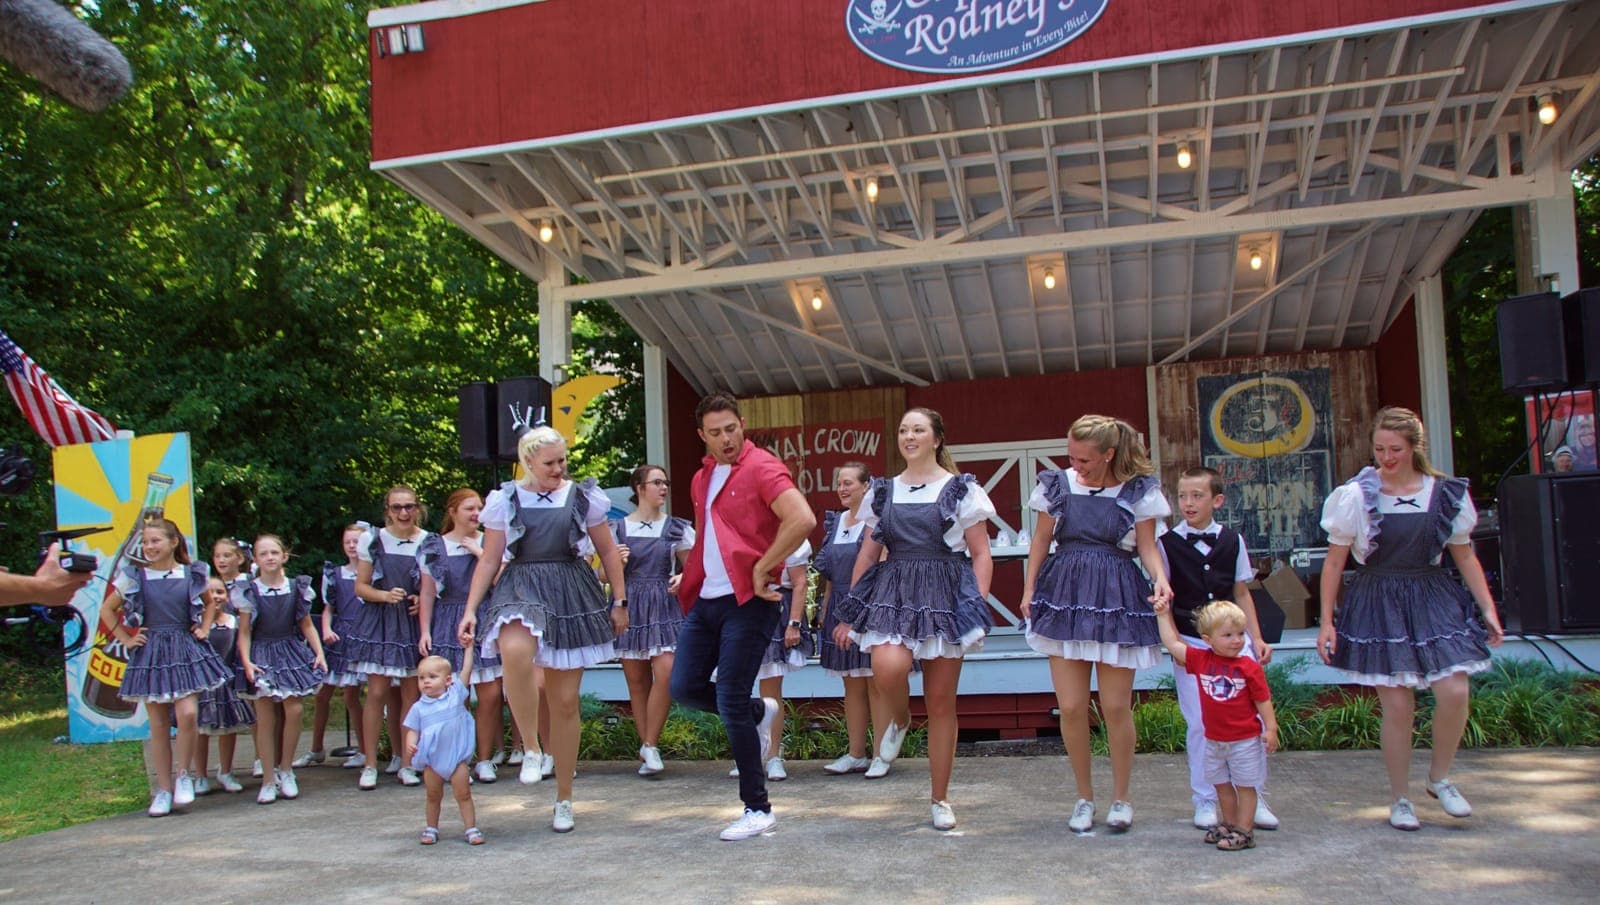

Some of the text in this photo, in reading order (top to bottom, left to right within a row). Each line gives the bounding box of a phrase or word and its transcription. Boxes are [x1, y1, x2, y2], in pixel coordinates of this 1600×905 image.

[904, 0, 1077, 56] Rodney
[947, 10, 1089, 66] An Adventure in Every Bite!
[767, 428, 880, 460] YAL CROWN
[797, 467, 840, 494] OL
[1242, 481, 1314, 510] MOON
[90, 652, 125, 682] COL
